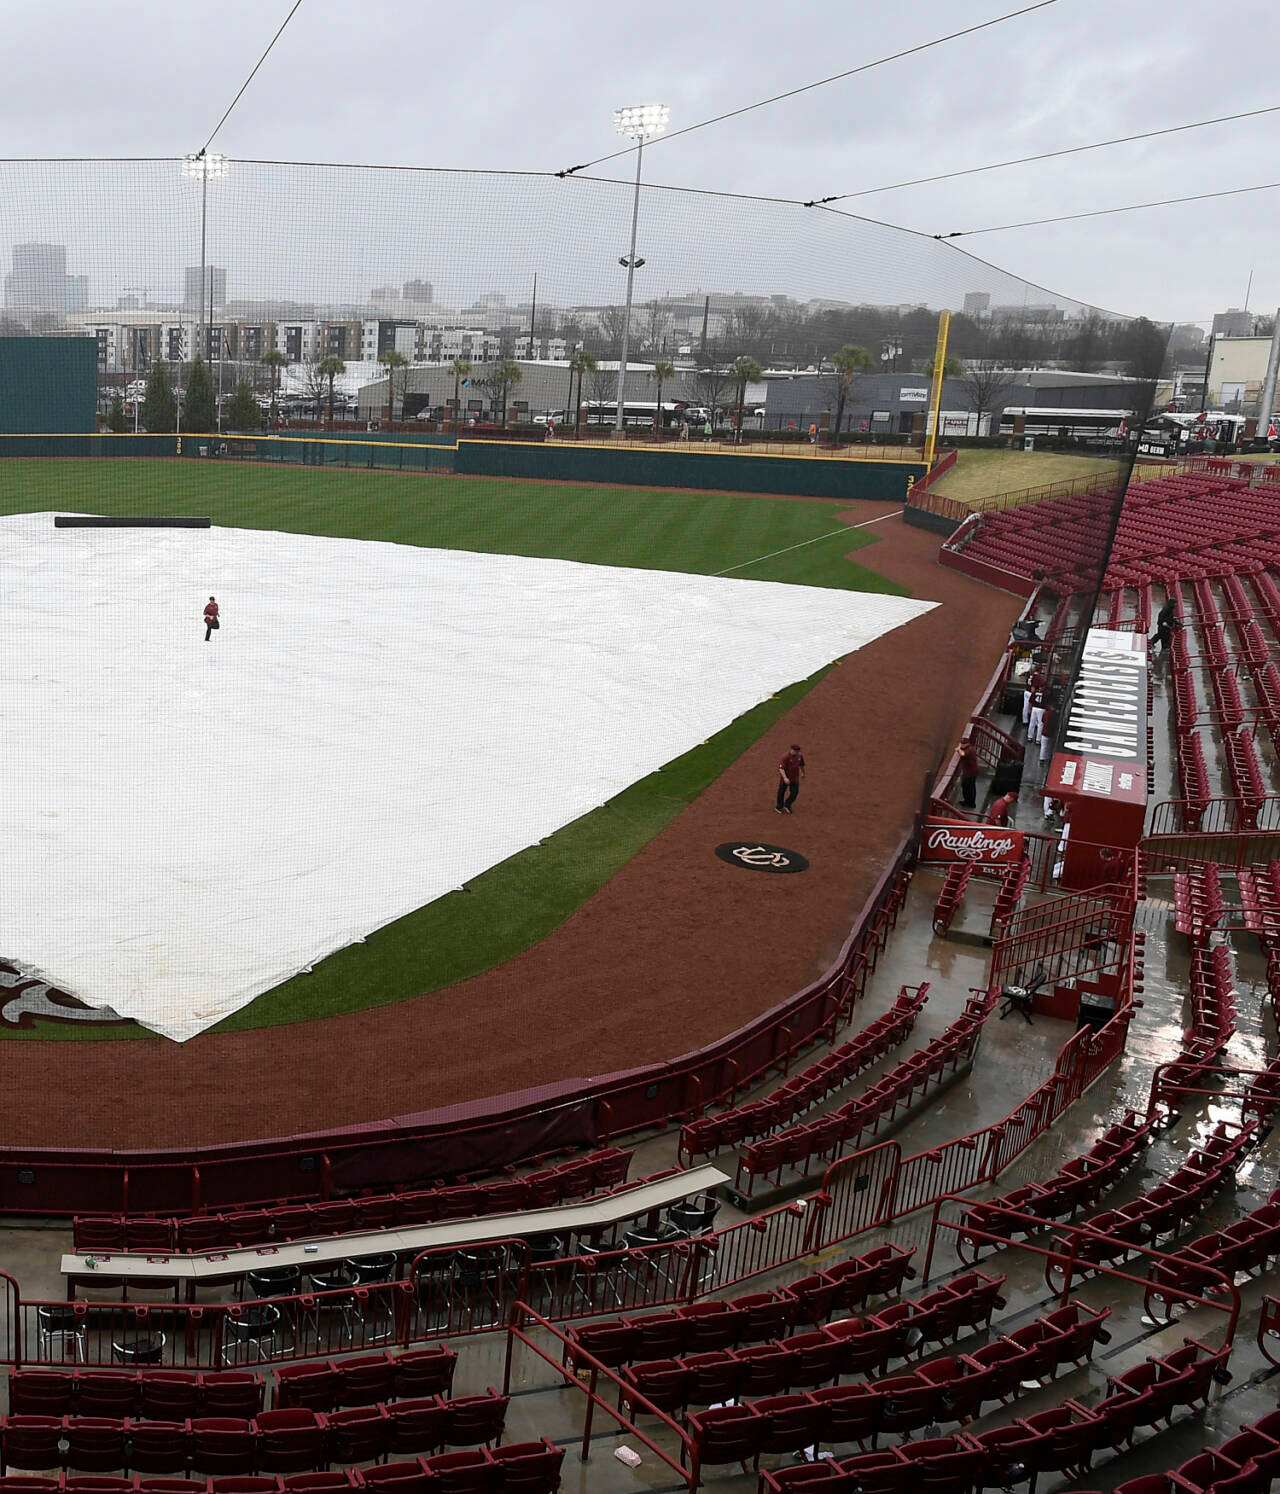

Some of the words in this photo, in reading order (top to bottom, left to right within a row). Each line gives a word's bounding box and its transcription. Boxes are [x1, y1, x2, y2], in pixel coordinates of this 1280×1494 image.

[1064, 663, 1140, 757] GAMECOCKS
[928, 829, 1016, 859] Rawlings
[982, 867, 997, 875] Est.
